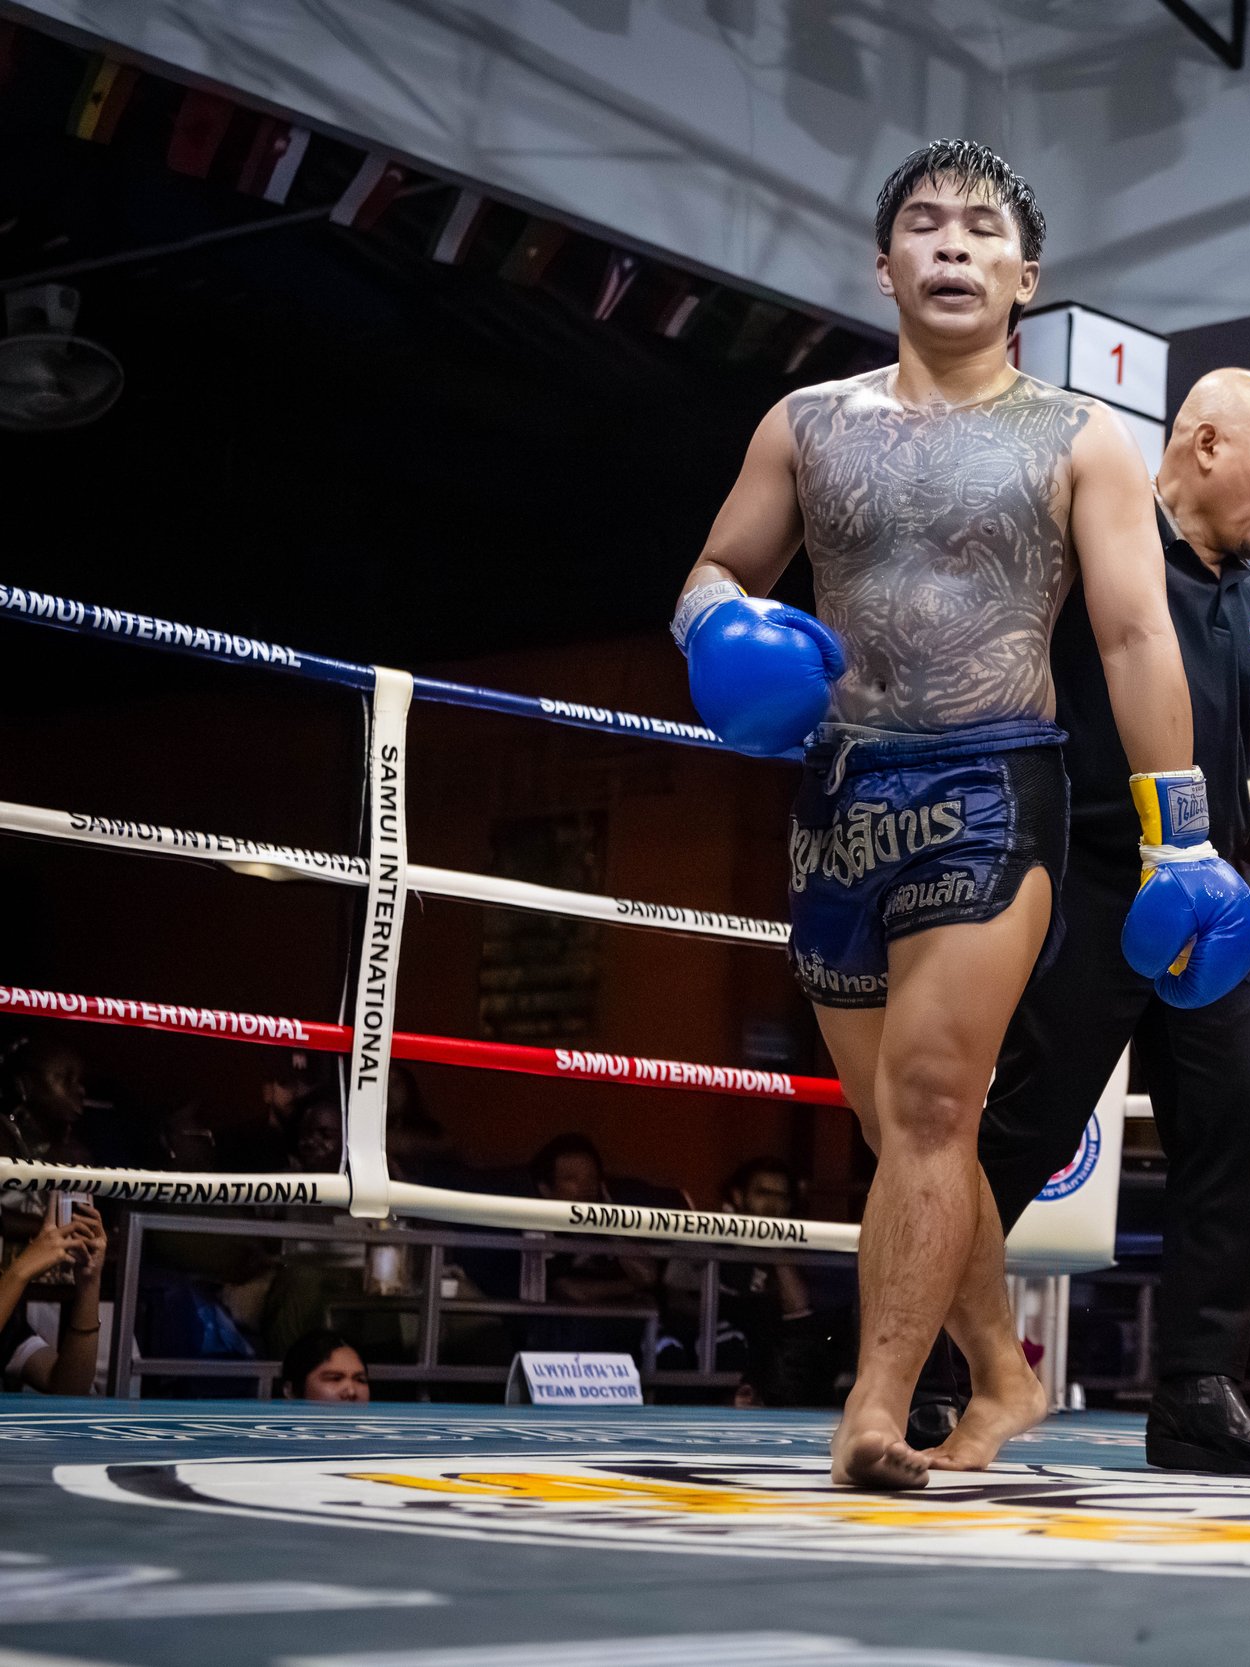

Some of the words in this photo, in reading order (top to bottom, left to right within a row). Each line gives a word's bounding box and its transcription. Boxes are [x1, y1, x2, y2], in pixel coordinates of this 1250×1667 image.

[1110, 342, 1124, 385] 1
[92, 606, 301, 667] INTERNATIONAL
[539, 698, 614, 724] SAMUI
[616, 711, 723, 742] INTERNAT
[380, 745, 398, 843] SAMUI
[70, 812, 164, 842] SAMUI
[615, 899, 687, 923] SAMUI
[357, 854, 398, 1090] INTERNATIONAL
[97, 997, 309, 1040] INTERNATIONAL
[555, 1049, 629, 1077] SAMUI
[634, 1057, 795, 1095] INTERNATIONAL
[107, 1181, 323, 1205] INTERNATIONAL
[569, 1205, 642, 1229] SAMUI
[649, 1211, 809, 1243] INTERNATIONAL
[537, 1384, 576, 1398] TEAM
[580, 1384, 638, 1398] DOCTOR
